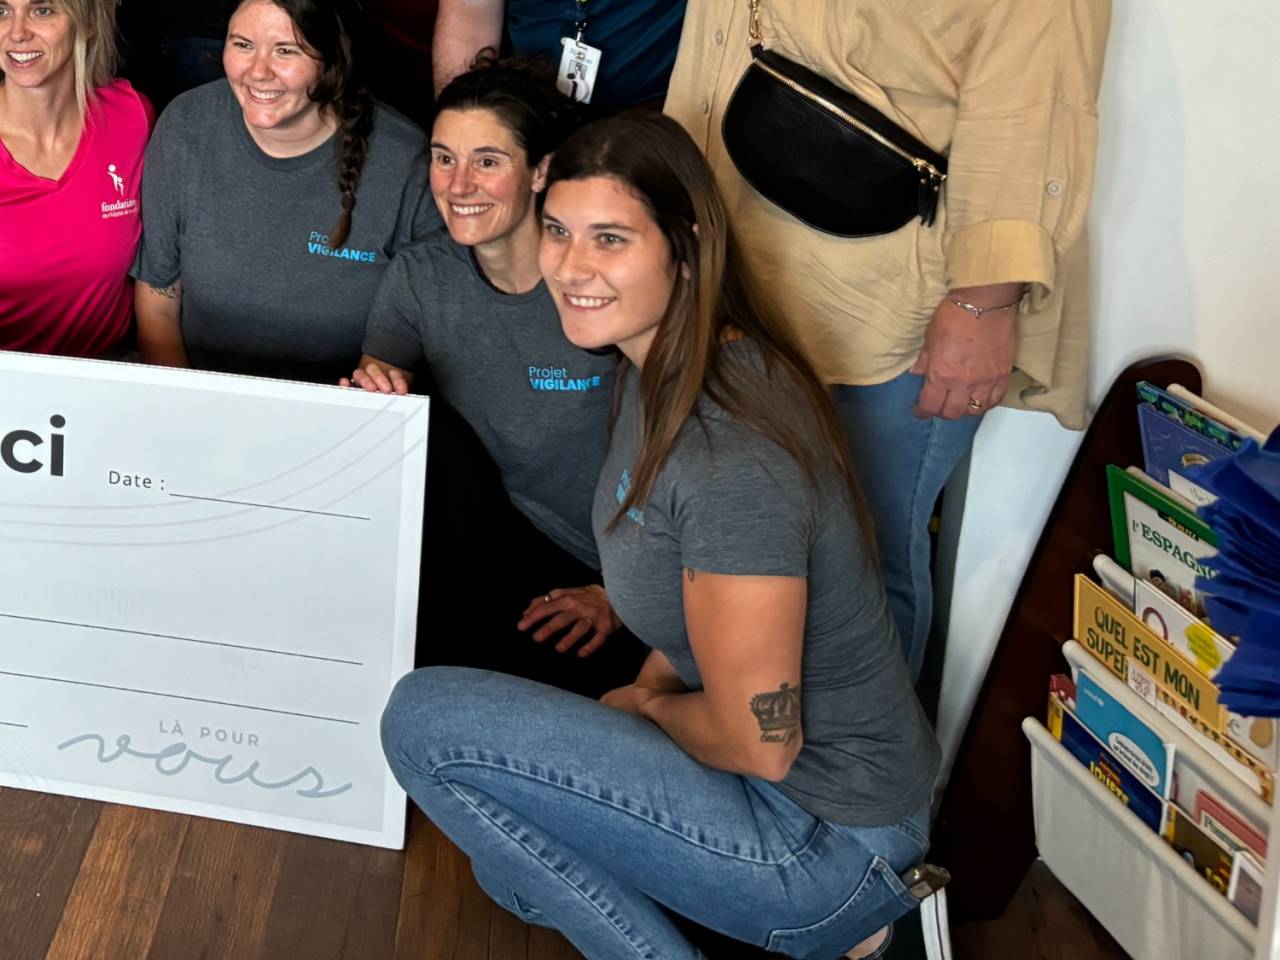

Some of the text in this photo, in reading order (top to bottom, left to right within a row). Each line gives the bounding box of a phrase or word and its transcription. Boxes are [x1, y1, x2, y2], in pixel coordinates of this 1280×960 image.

[309, 231, 329, 244] Pro
[528, 366, 568, 379] Projet
[108, 470, 153, 490] Date
[1094, 606, 1129, 650] QUEL
[1132, 635, 1161, 675] EST
[1164, 660, 1200, 712] MON
[159, 719, 261, 748] LÀ POUR
[56, 733, 353, 799] vous
